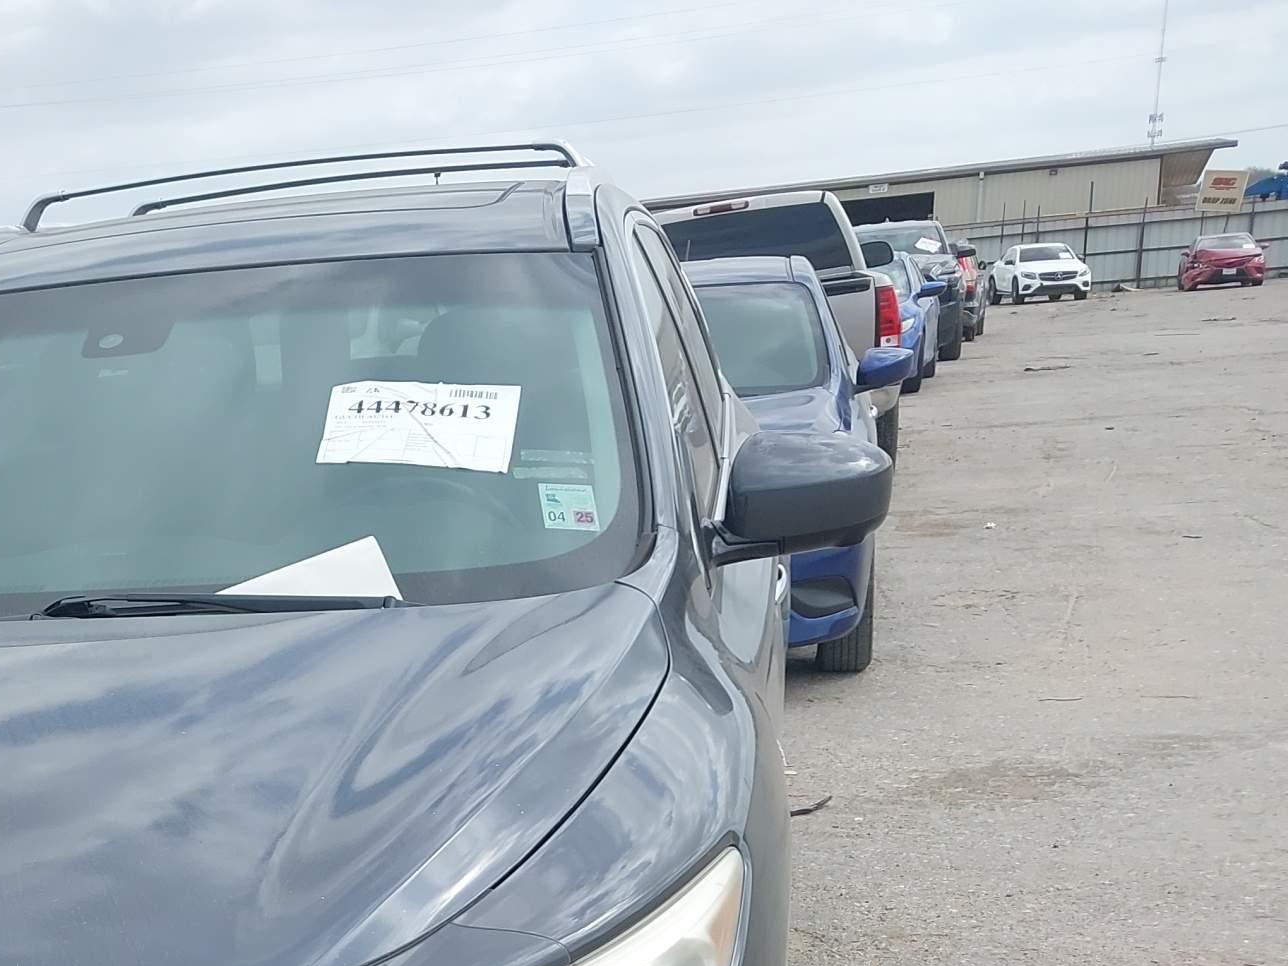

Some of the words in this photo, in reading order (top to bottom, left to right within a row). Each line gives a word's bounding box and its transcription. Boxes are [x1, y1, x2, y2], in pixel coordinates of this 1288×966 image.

[348, 399, 492, 420] 44478613
[548, 510, 566, 522] 04
[575, 511, 594, 523] 25
